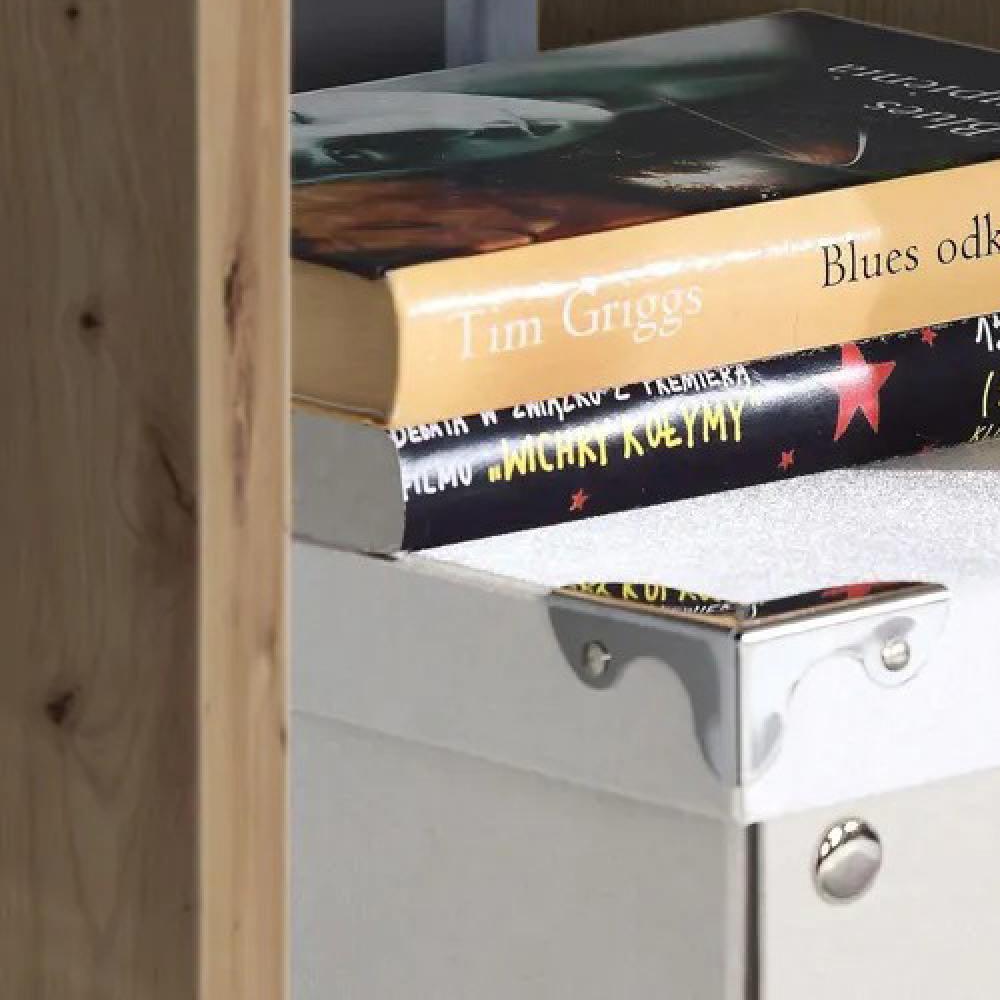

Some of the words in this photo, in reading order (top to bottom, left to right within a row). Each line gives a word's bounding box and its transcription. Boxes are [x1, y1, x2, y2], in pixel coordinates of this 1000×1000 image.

[821, 239, 920, 288] Blues
[459, 308, 544, 360] Tim
[561, 284, 704, 344] Griggs
